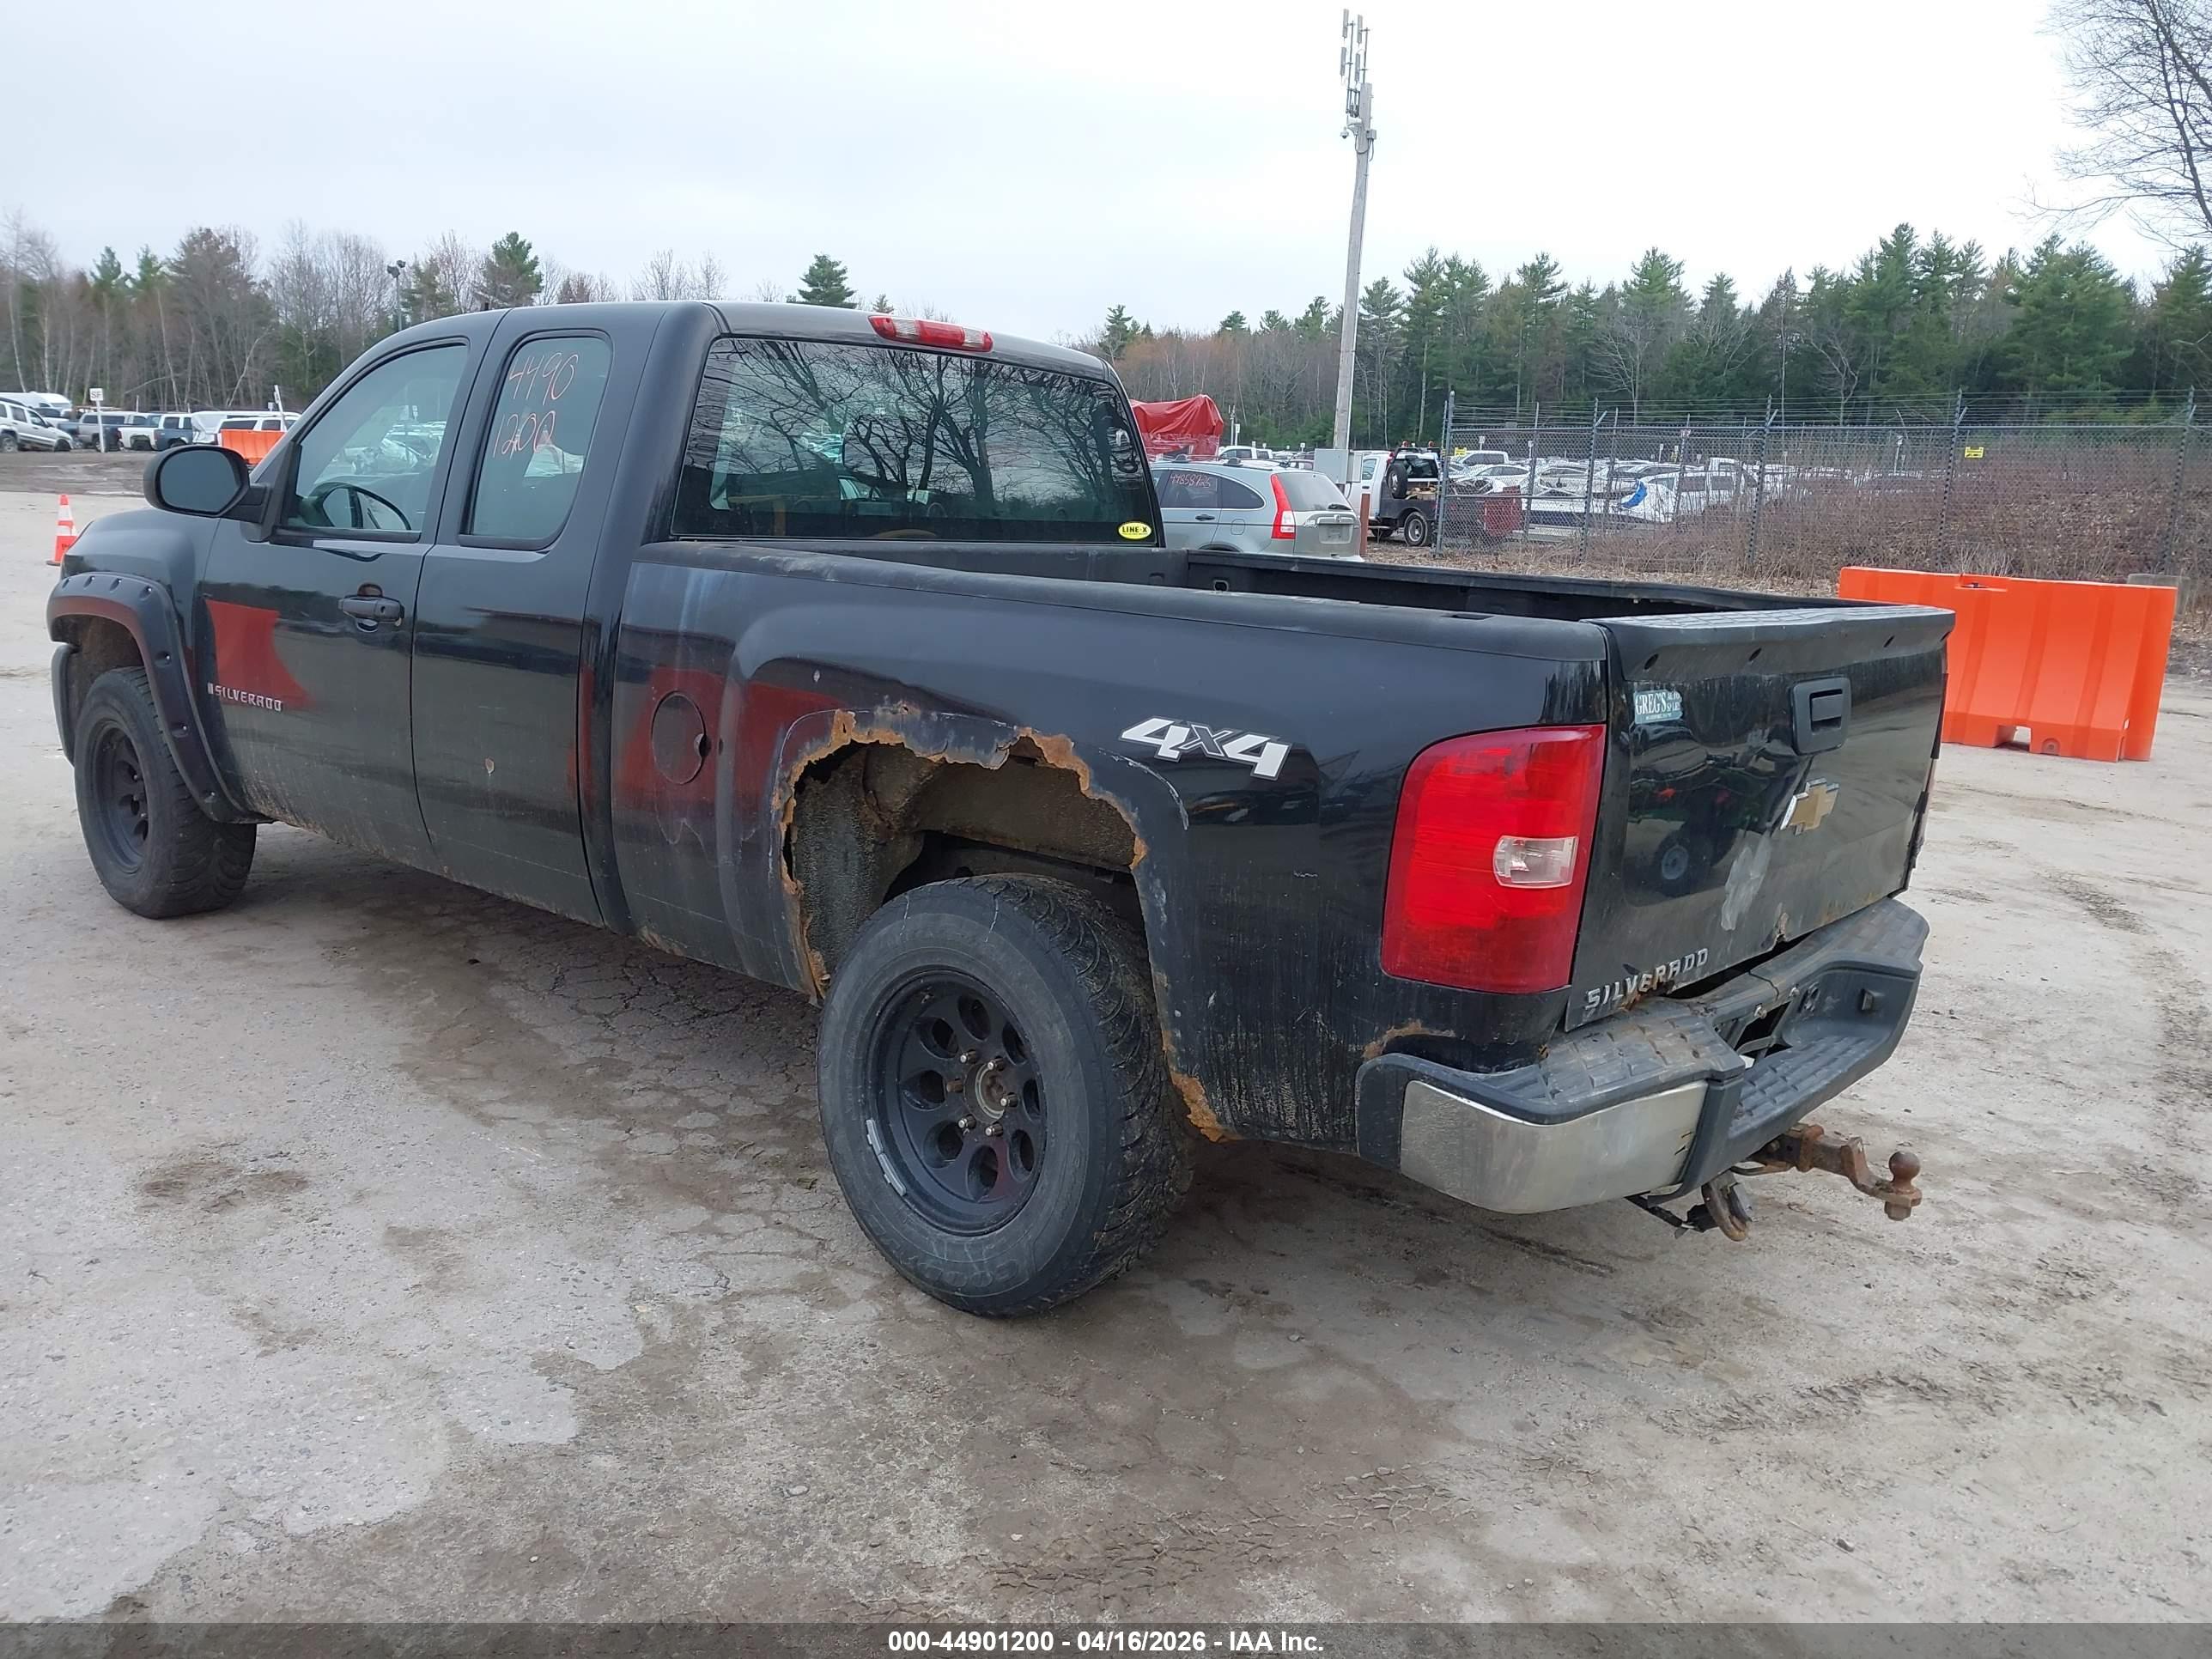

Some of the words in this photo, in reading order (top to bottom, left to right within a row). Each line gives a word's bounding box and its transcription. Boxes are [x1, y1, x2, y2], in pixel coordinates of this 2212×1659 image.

[508, 352, 578, 406] 4490
[493, 410, 556, 459] 1200
[215, 684, 282, 712] SILVERADO
[1635, 692, 1667, 715] GREG'S
[1584, 947, 1709, 1012] SILVERADO
